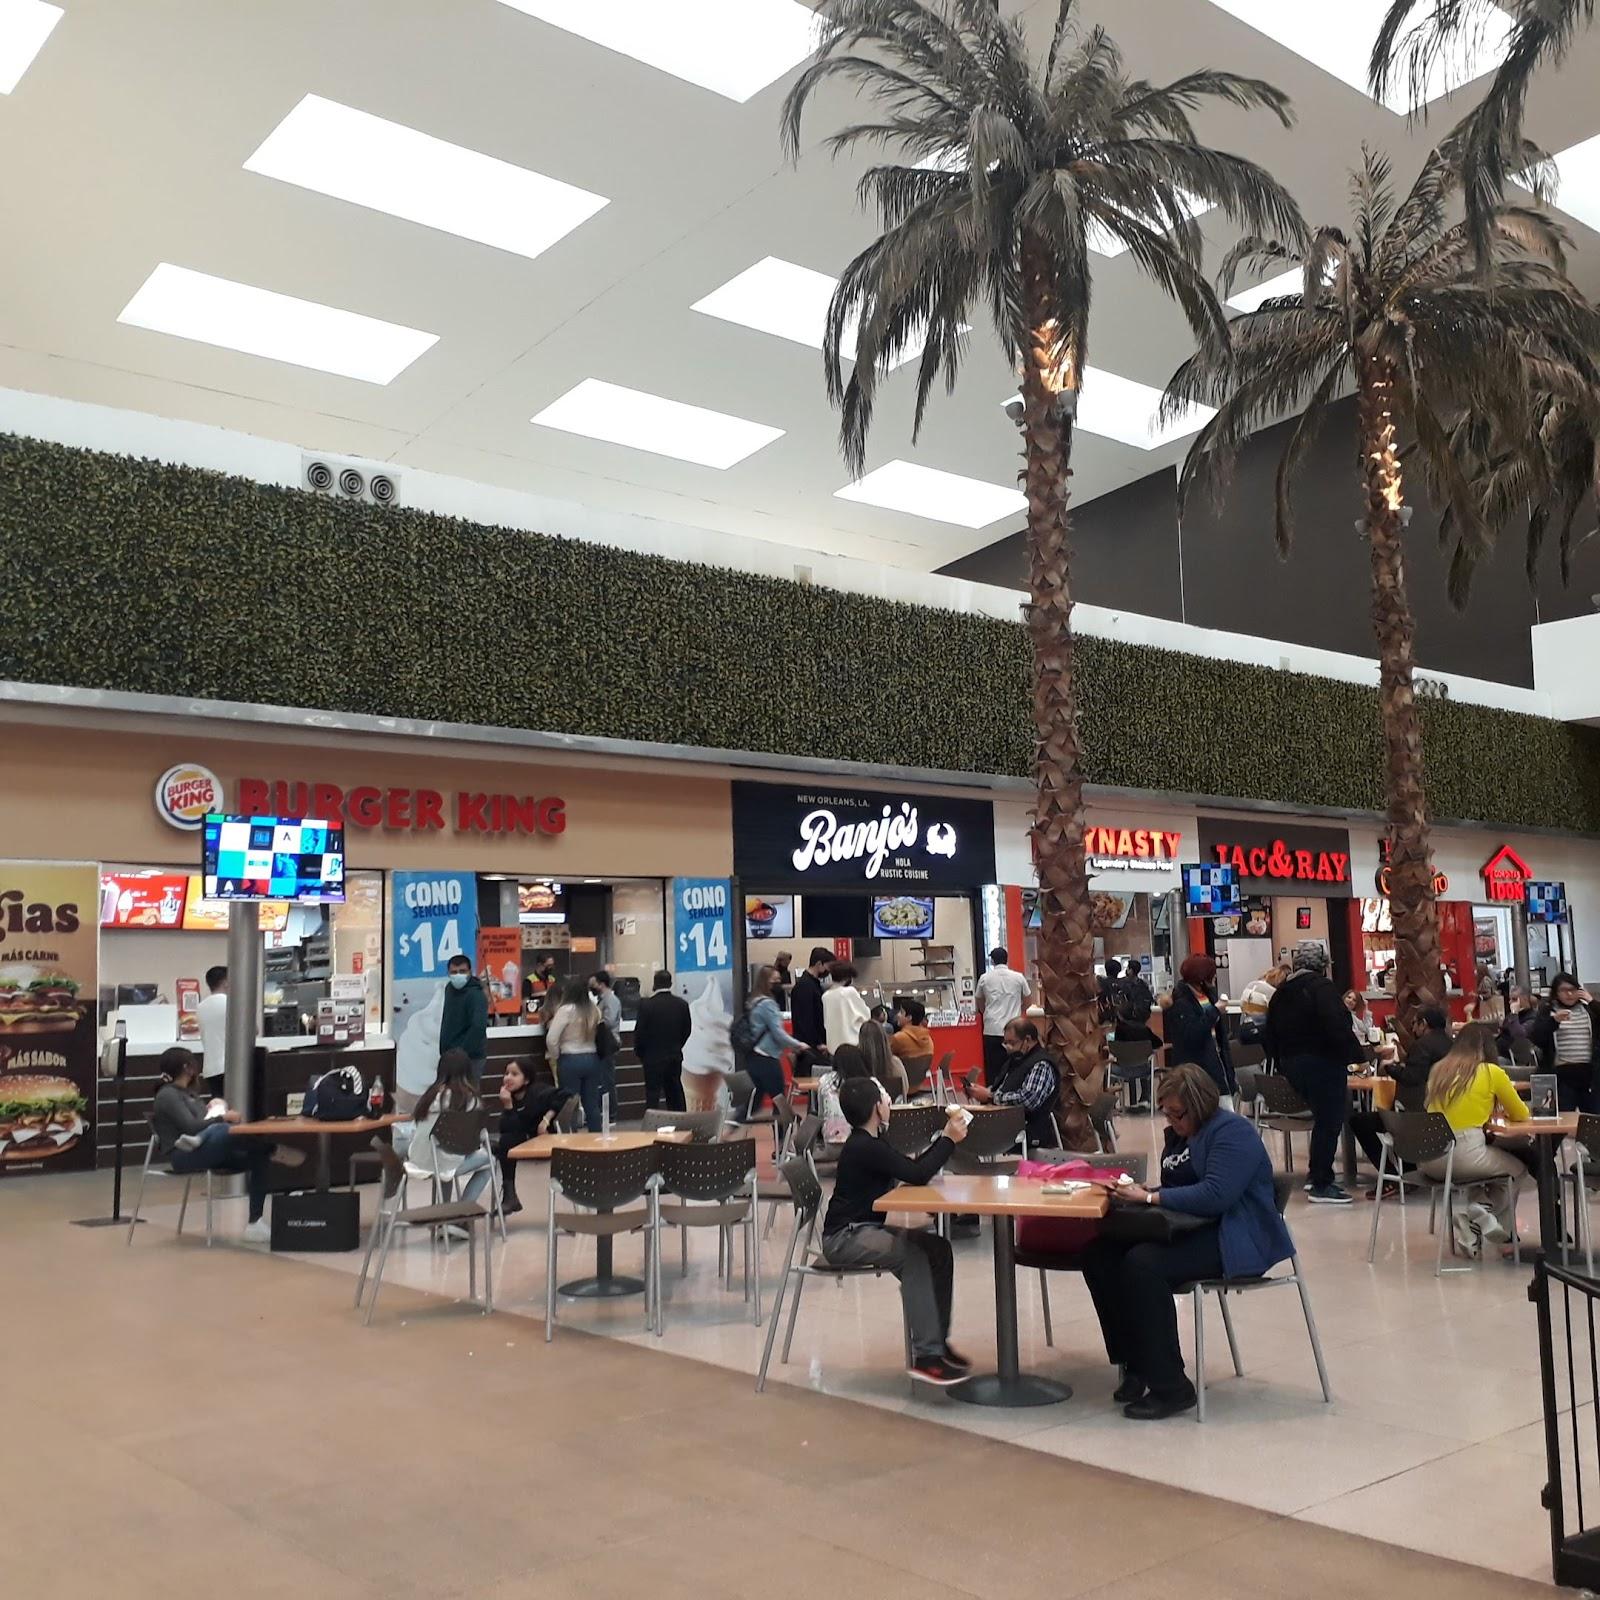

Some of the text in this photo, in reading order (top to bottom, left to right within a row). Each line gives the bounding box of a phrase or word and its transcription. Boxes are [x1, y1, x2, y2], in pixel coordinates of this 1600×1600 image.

[167, 778, 212, 797] BURGER
[169, 788, 214, 813] KING
[239, 778, 567, 835] BURGER KING
[797, 795, 871, 808] NEW ORLEANS, LA.
[792, 801, 919, 880] Banjo's
[880, 868, 929, 880] RUSTIC CUISINE
[895, 858, 912, 868] NOLA
[405, 879, 462, 909] CONO
[683, 885, 726, 911] CONO
[0, 889, 80, 943] ías
[412, 903, 459, 919] SENCILLO
[688, 906, 724, 920] SENCILLO
[400, 919, 463, 972] $14
[680, 920, 728, 967] $14
[7, 1049, 67, 1070] MÁS SABOR
